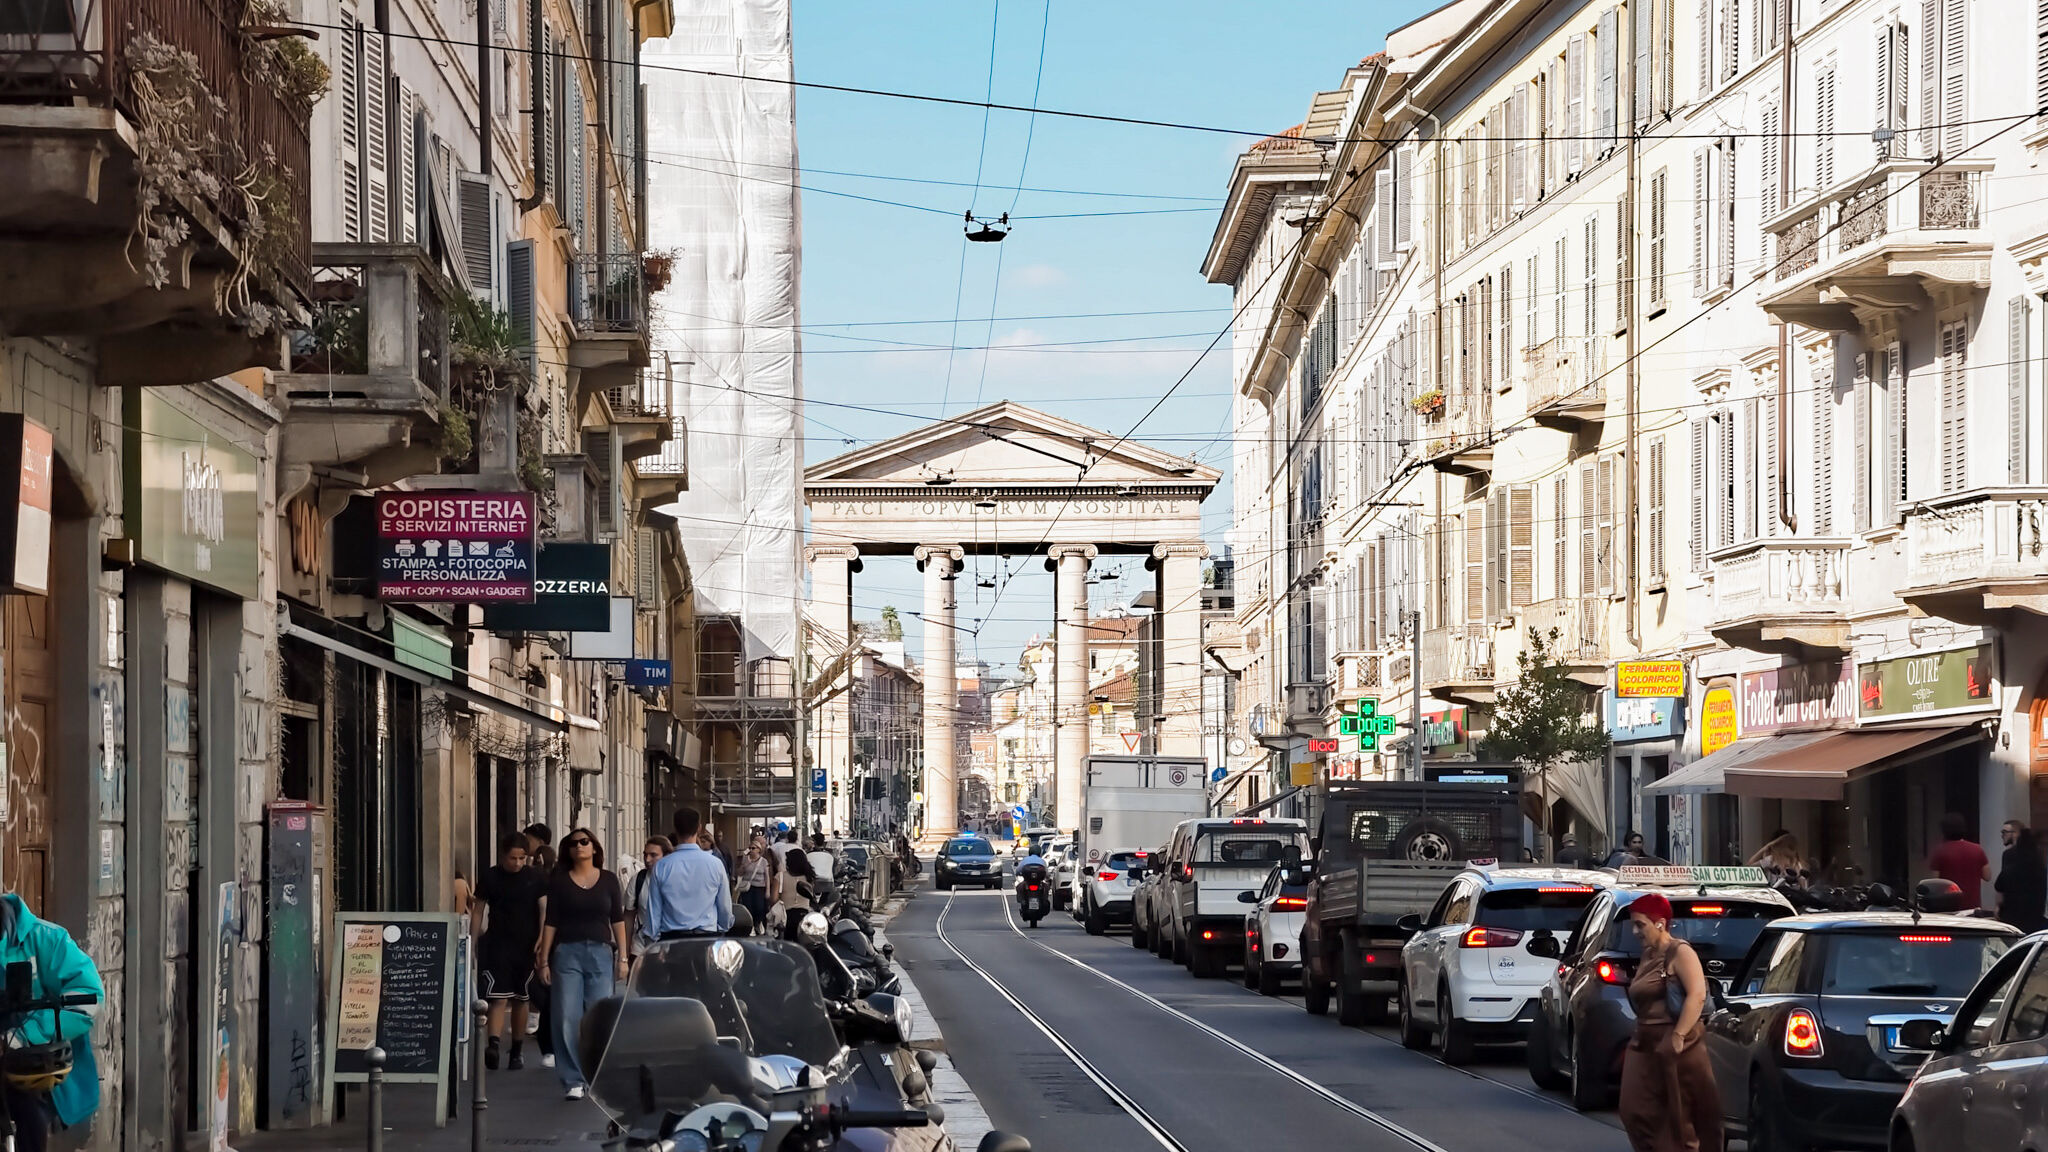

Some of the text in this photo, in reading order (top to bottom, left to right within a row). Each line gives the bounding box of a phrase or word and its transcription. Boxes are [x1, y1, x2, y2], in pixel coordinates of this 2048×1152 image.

[381, 499, 527, 519] COPISTERIA
[831, 501, 884, 515] PACI
[1073, 501, 1180, 515] SOSPITAE
[382, 520, 527, 532] E SERVIZI INTERNET
[382, 558, 527, 570] STAMPA FOTOCOPIA
[402, 570, 507, 581] PERSONALIZZA
[382, 586, 527, 596] PRINT COPY SCAN GADGET
[535, 580, 609, 594] OZZERIA
[643, 667, 667, 678] TIM
[1624, 665, 1681, 673] FERRAMENTA
[1906, 657, 1941, 686] OLTRE
[1624, 675, 1680, 684] COLORIFICIO
[1743, 674, 1798, 727] Foderami
[1800, 671, 1852, 723] Carcano
[814, 769, 824, 782] P
[1622, 866, 1763, 882] SCUOLA GUIDA SAN GOTTARDO
